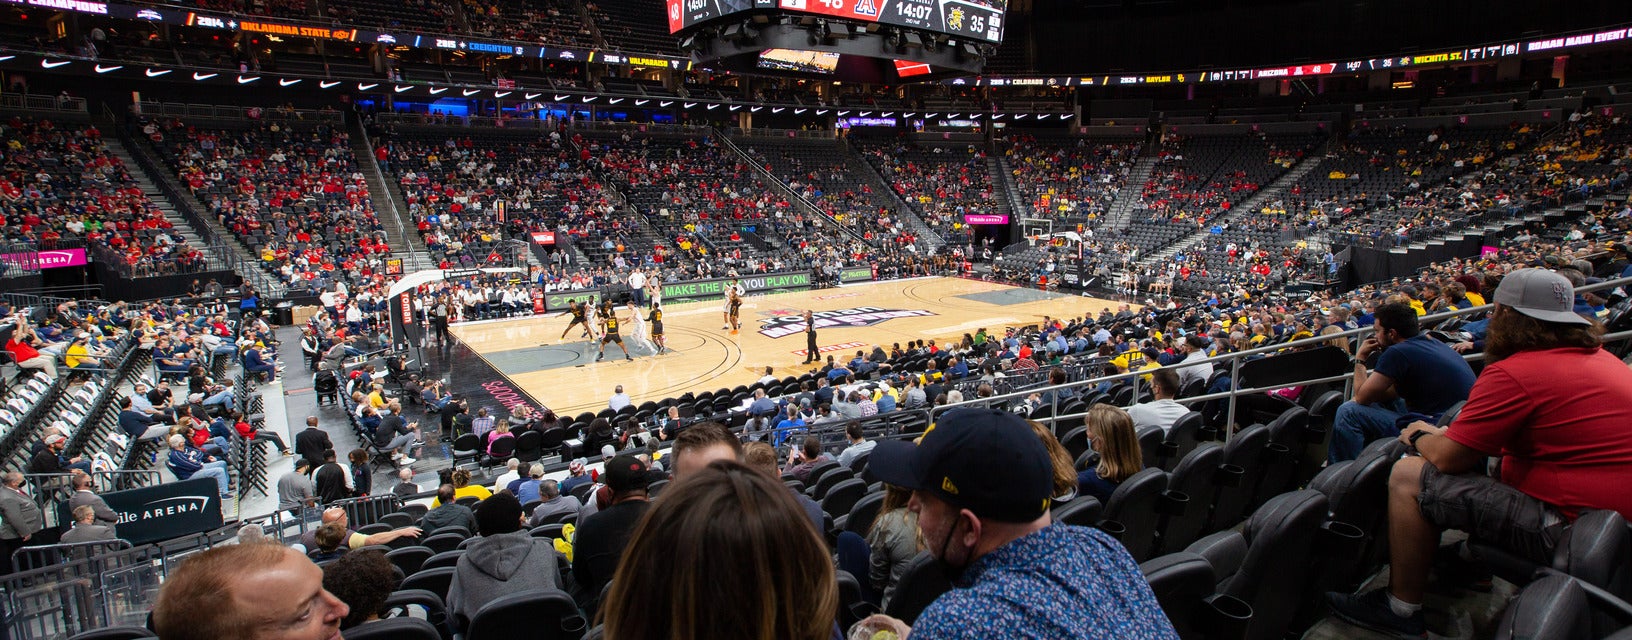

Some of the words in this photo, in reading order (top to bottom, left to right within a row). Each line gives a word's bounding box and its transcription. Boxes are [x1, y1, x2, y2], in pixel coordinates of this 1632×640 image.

[671, 3, 680, 21] 48
[896, 2, 932, 20] 14:07
[197, 16, 224, 28] 2014
[240, 21, 299, 35] OKLAHOMA
[300, 27, 331, 38] STATE
[970, 15, 984, 33] 35
[436, 39, 457, 48] 2015
[469, 42, 513, 53] CREIGHTON
[1528, 39, 1564, 51] ROMAN
[1565, 35, 1593, 47] MAIN
[1594, 29, 1626, 43] EVENT
[629, 57, 668, 67] VALPARAISO
[1346, 61, 1361, 69] 14:07
[1383, 59, 1392, 67] 35
[1413, 54, 1448, 64] WICHITA
[1449, 51, 1463, 60] ST.
[1258, 69, 1288, 77] ARIZONA
[665, 284, 697, 297] MAKE
[698, 281, 721, 293] THE
[743, 279, 765, 289] YOU
[766, 276, 790, 287] PLAY
[792, 274, 809, 284] ON.
[402, 293, 412, 323] roman
[143, 502, 198, 520] ARENA
